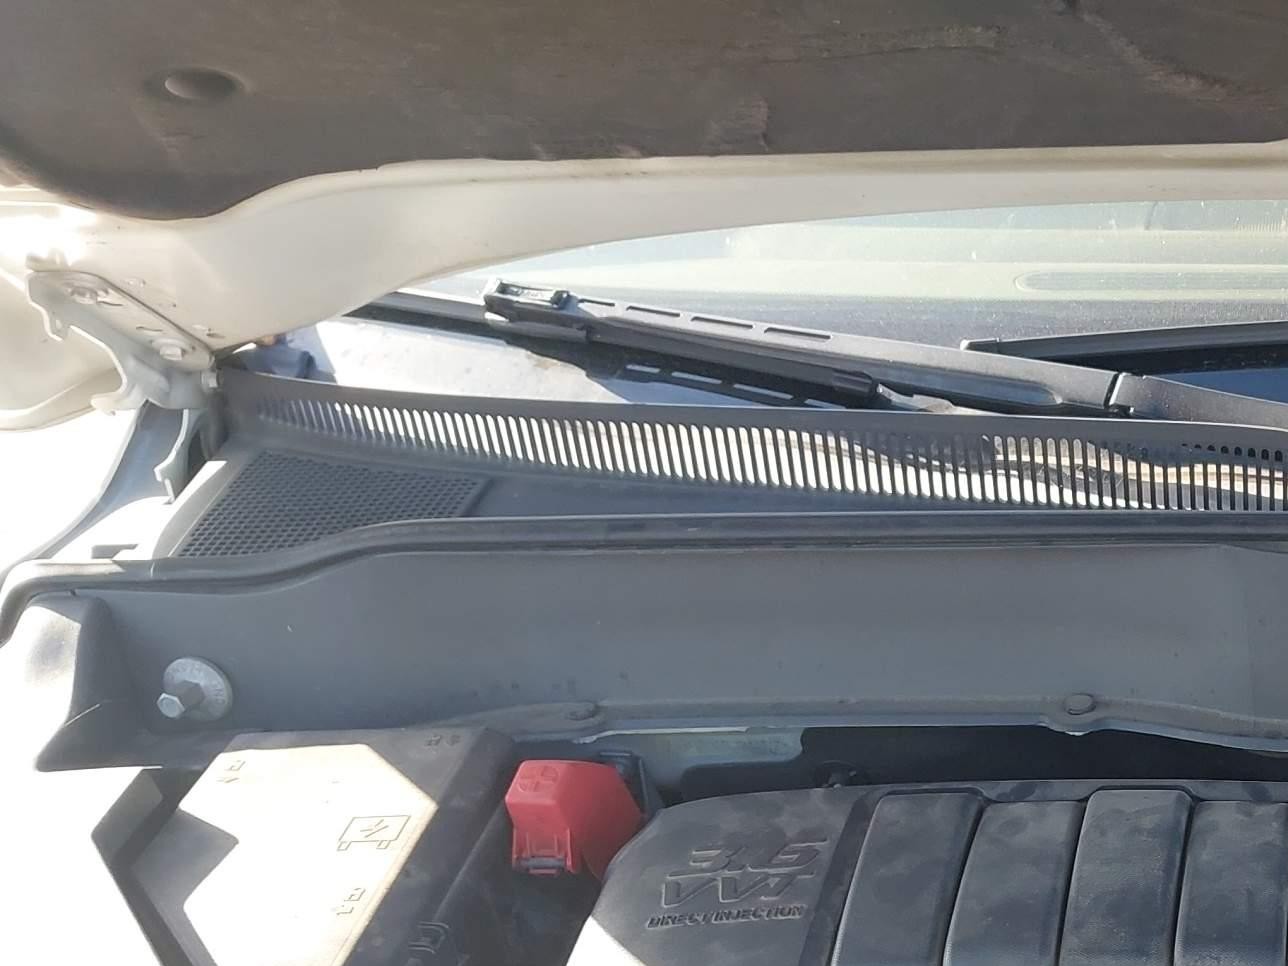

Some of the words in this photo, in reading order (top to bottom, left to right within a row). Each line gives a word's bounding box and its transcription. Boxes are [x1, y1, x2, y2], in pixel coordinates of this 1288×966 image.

[662, 868, 815, 908] VVT
[647, 911, 710, 929] DIRECT
[711, 904, 804, 924] INJECTION
